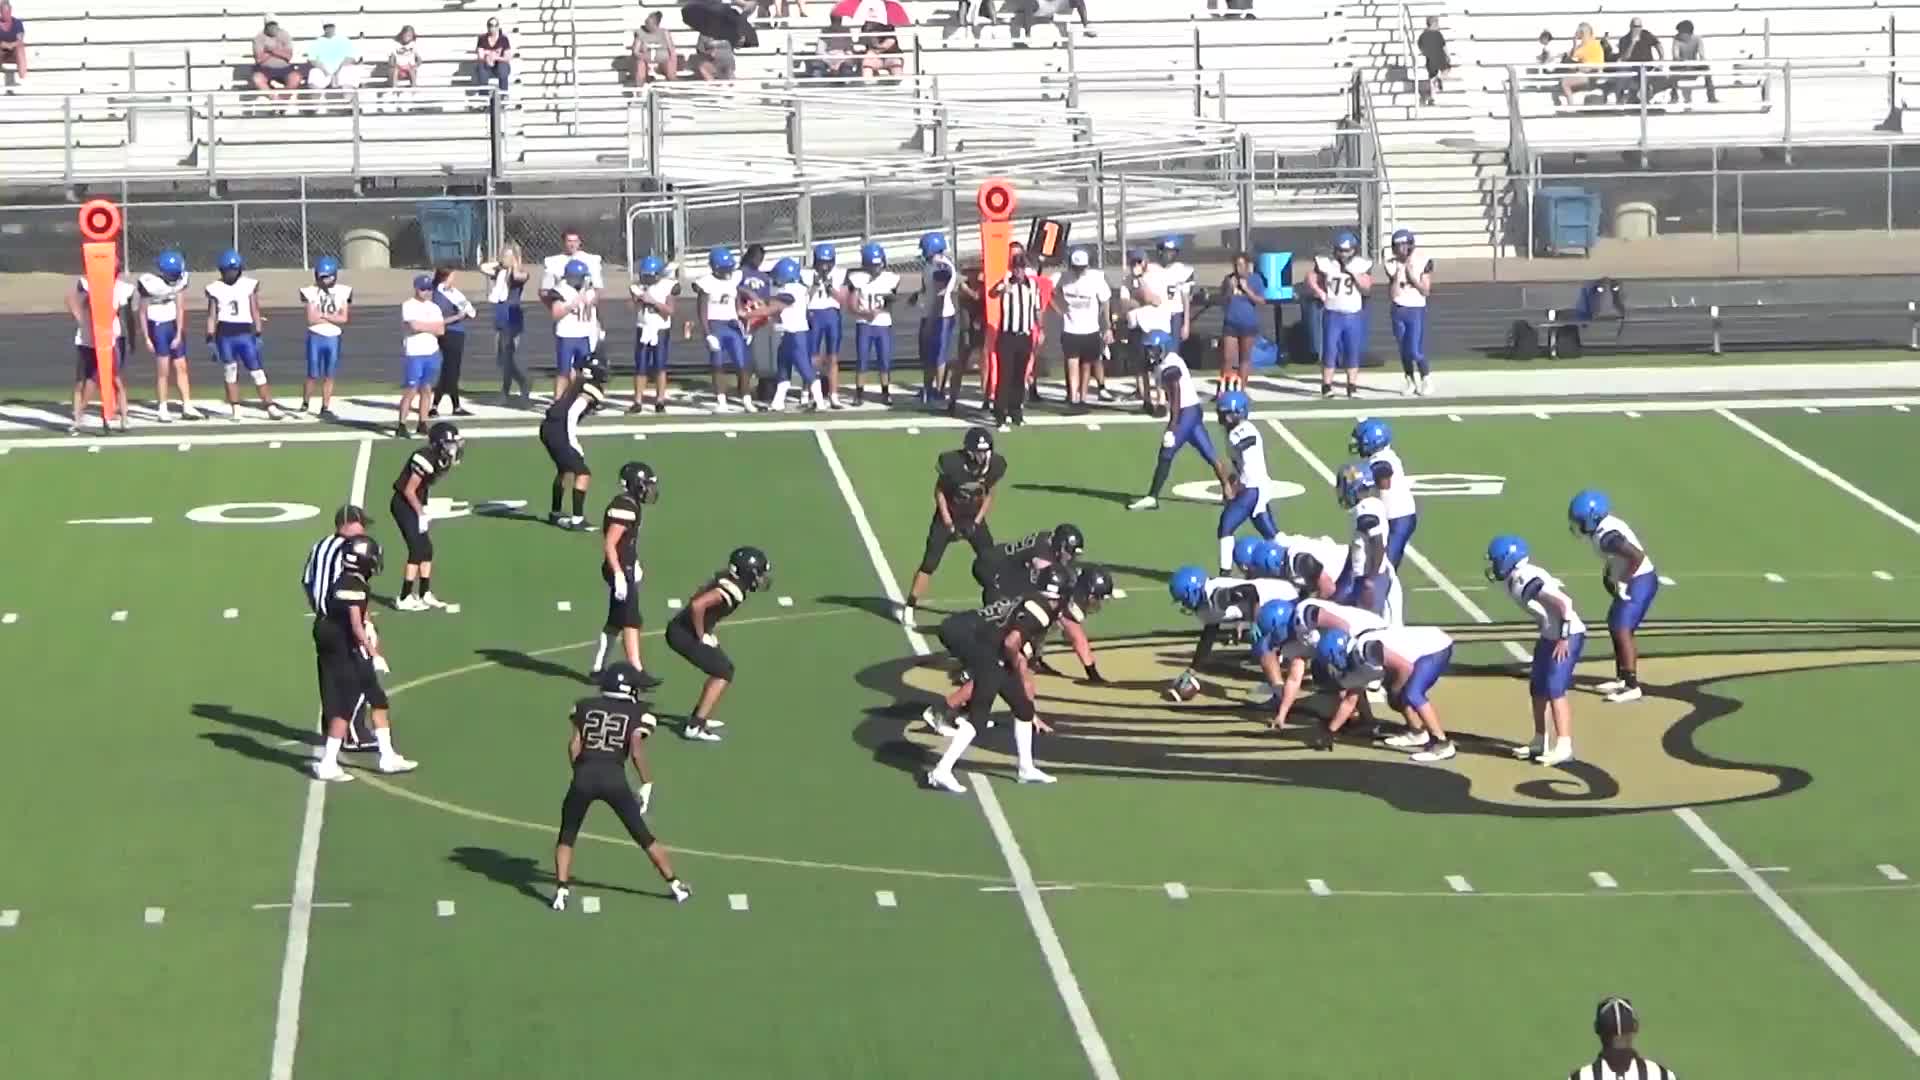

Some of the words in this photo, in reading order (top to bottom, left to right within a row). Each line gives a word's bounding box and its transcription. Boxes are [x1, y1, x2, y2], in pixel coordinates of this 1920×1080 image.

[1042, 221, 1060, 257] 1
[1331, 277, 1354, 297] 79
[230, 300, 239, 316] 3
[583, 709, 630, 752] 22
